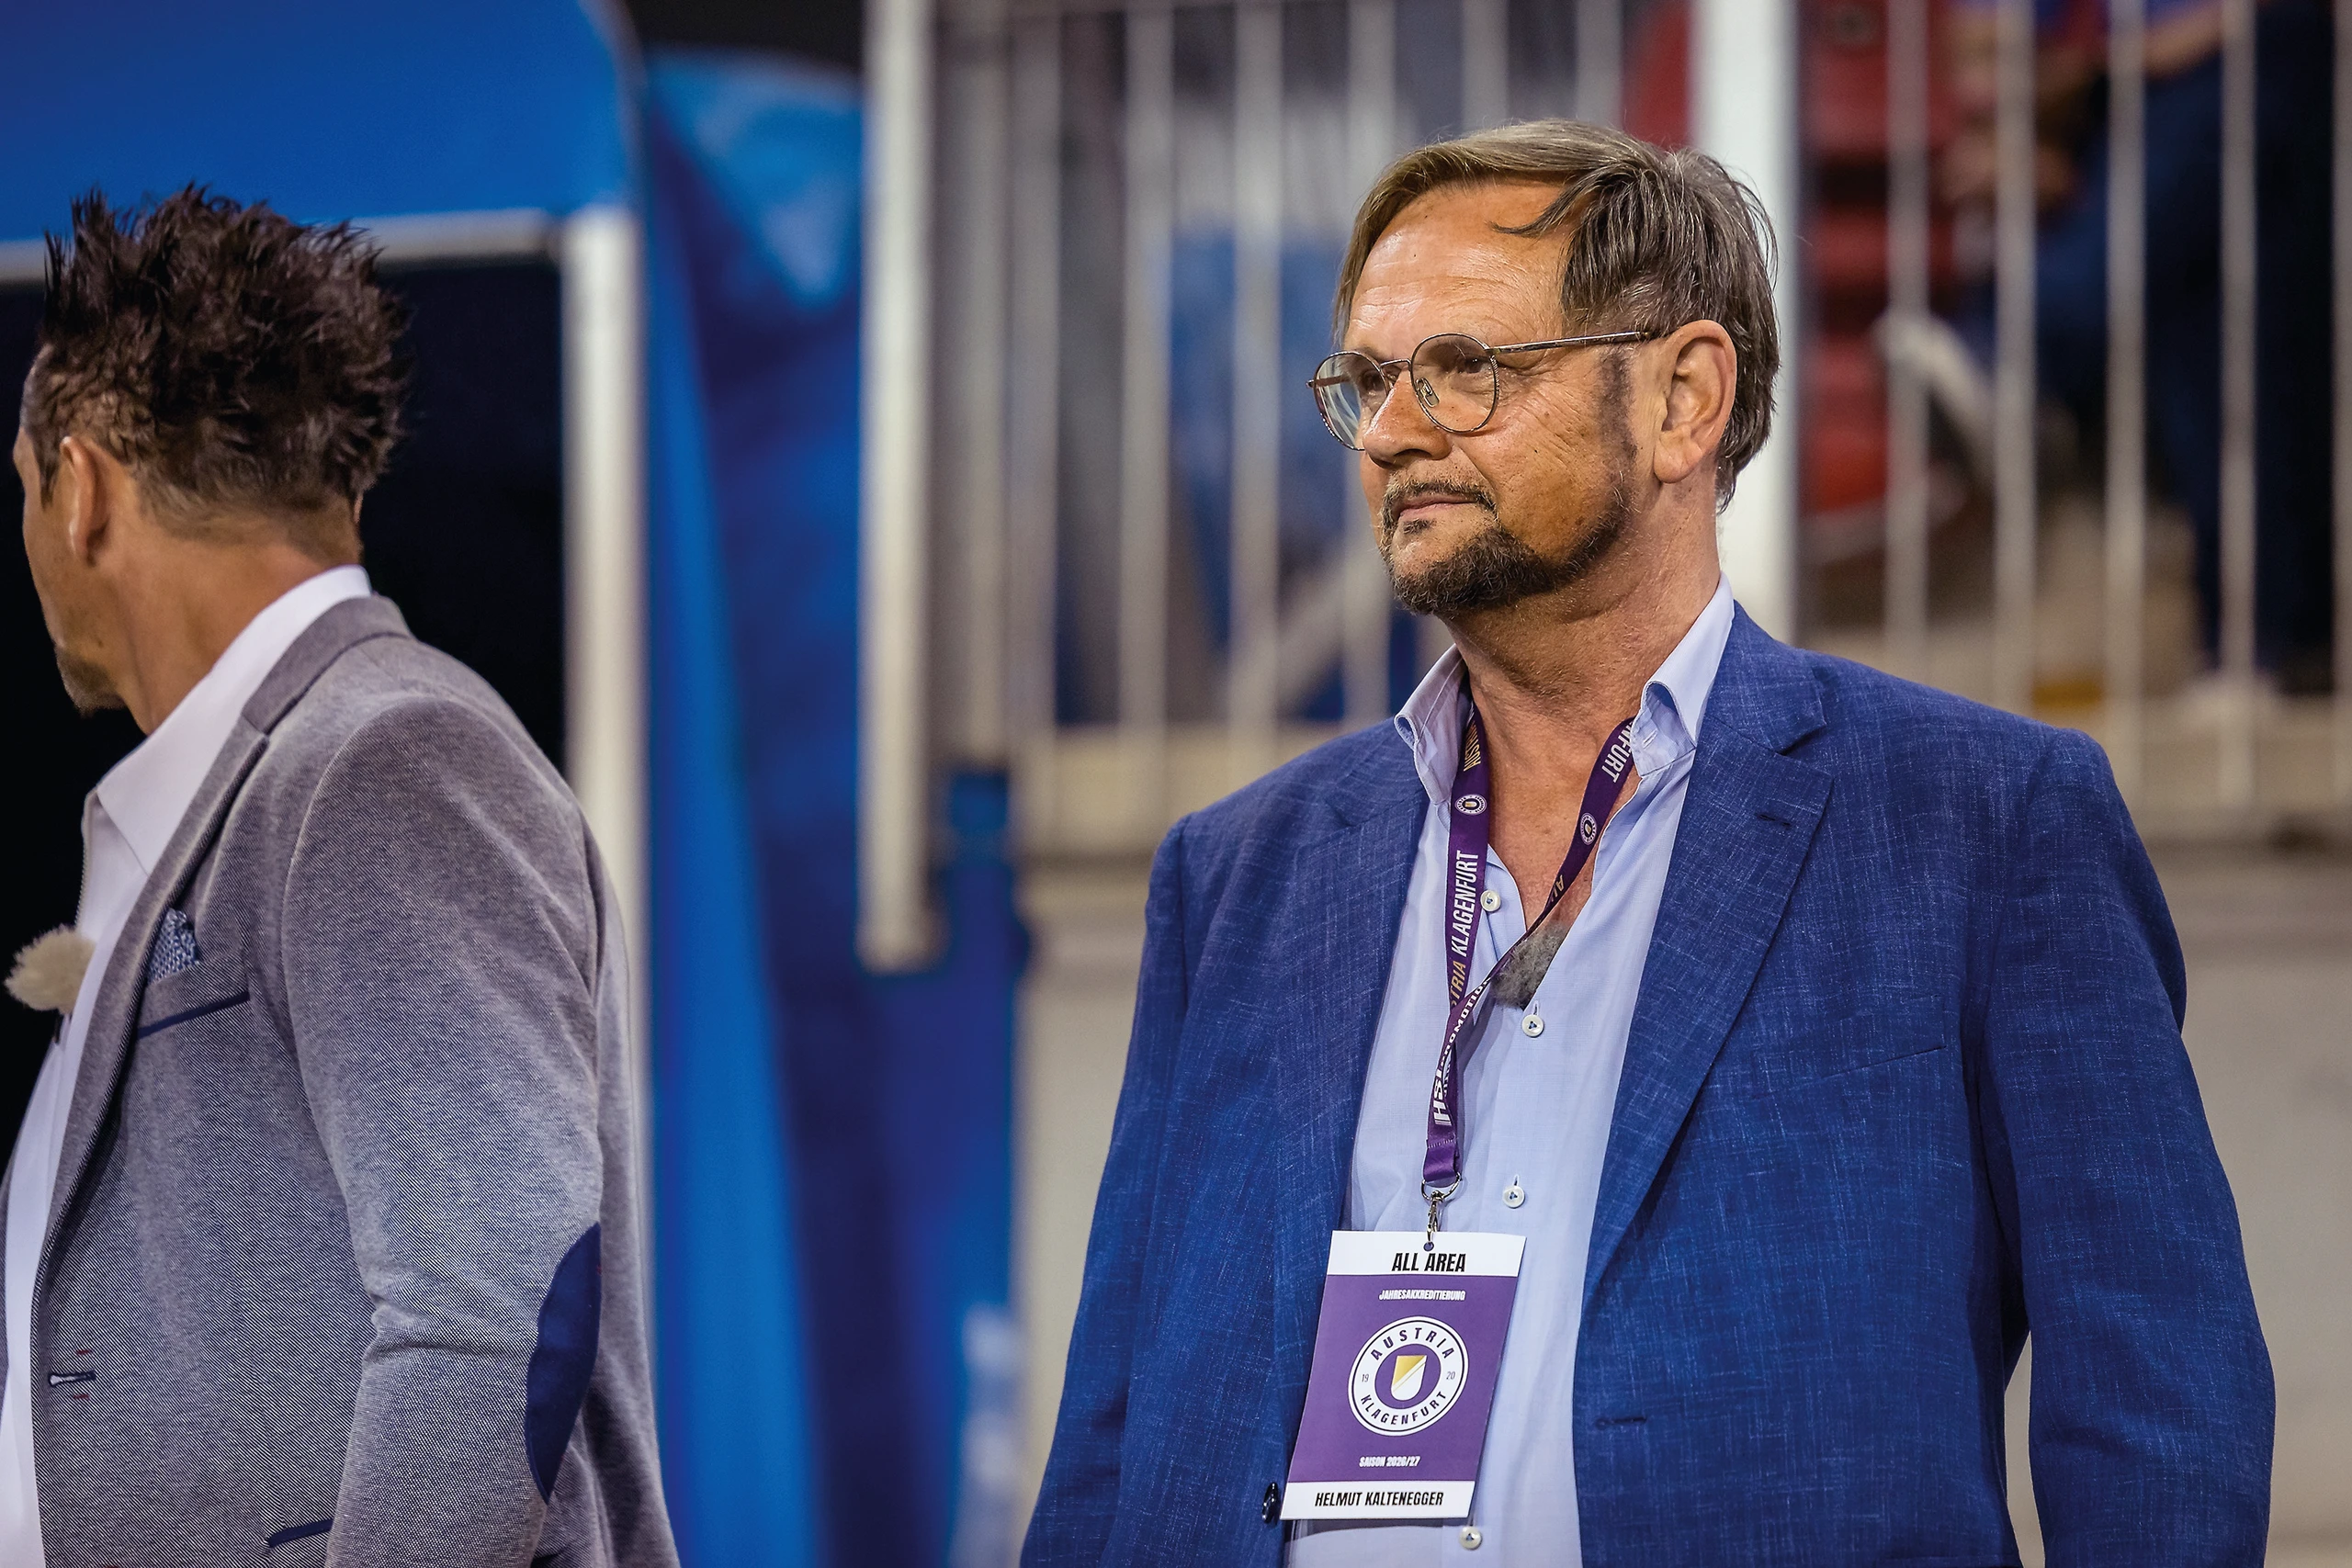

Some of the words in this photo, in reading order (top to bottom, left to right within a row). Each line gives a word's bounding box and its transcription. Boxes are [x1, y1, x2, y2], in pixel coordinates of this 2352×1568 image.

[1451, 850, 1478, 957] KLAGENFURT
[1391, 1252, 1419, 1271] ALL
[1423, 1252, 1466, 1272] AREA
[1378, 1289, 1466, 1301] JAHRESAKKREDITIERUNG
[1370, 1327, 1455, 1360] AUSTRIA
[1361, 1373, 1370, 1382] 19
[1445, 1371, 1456, 1380] 20
[1360, 1391, 1447, 1426] KLAGENFURT
[1359, 1456, 1386, 1467] SAISON
[1315, 1492, 1363, 1506] HELMUT
[1364, 1491, 1444, 1506] KALTENEGGER
